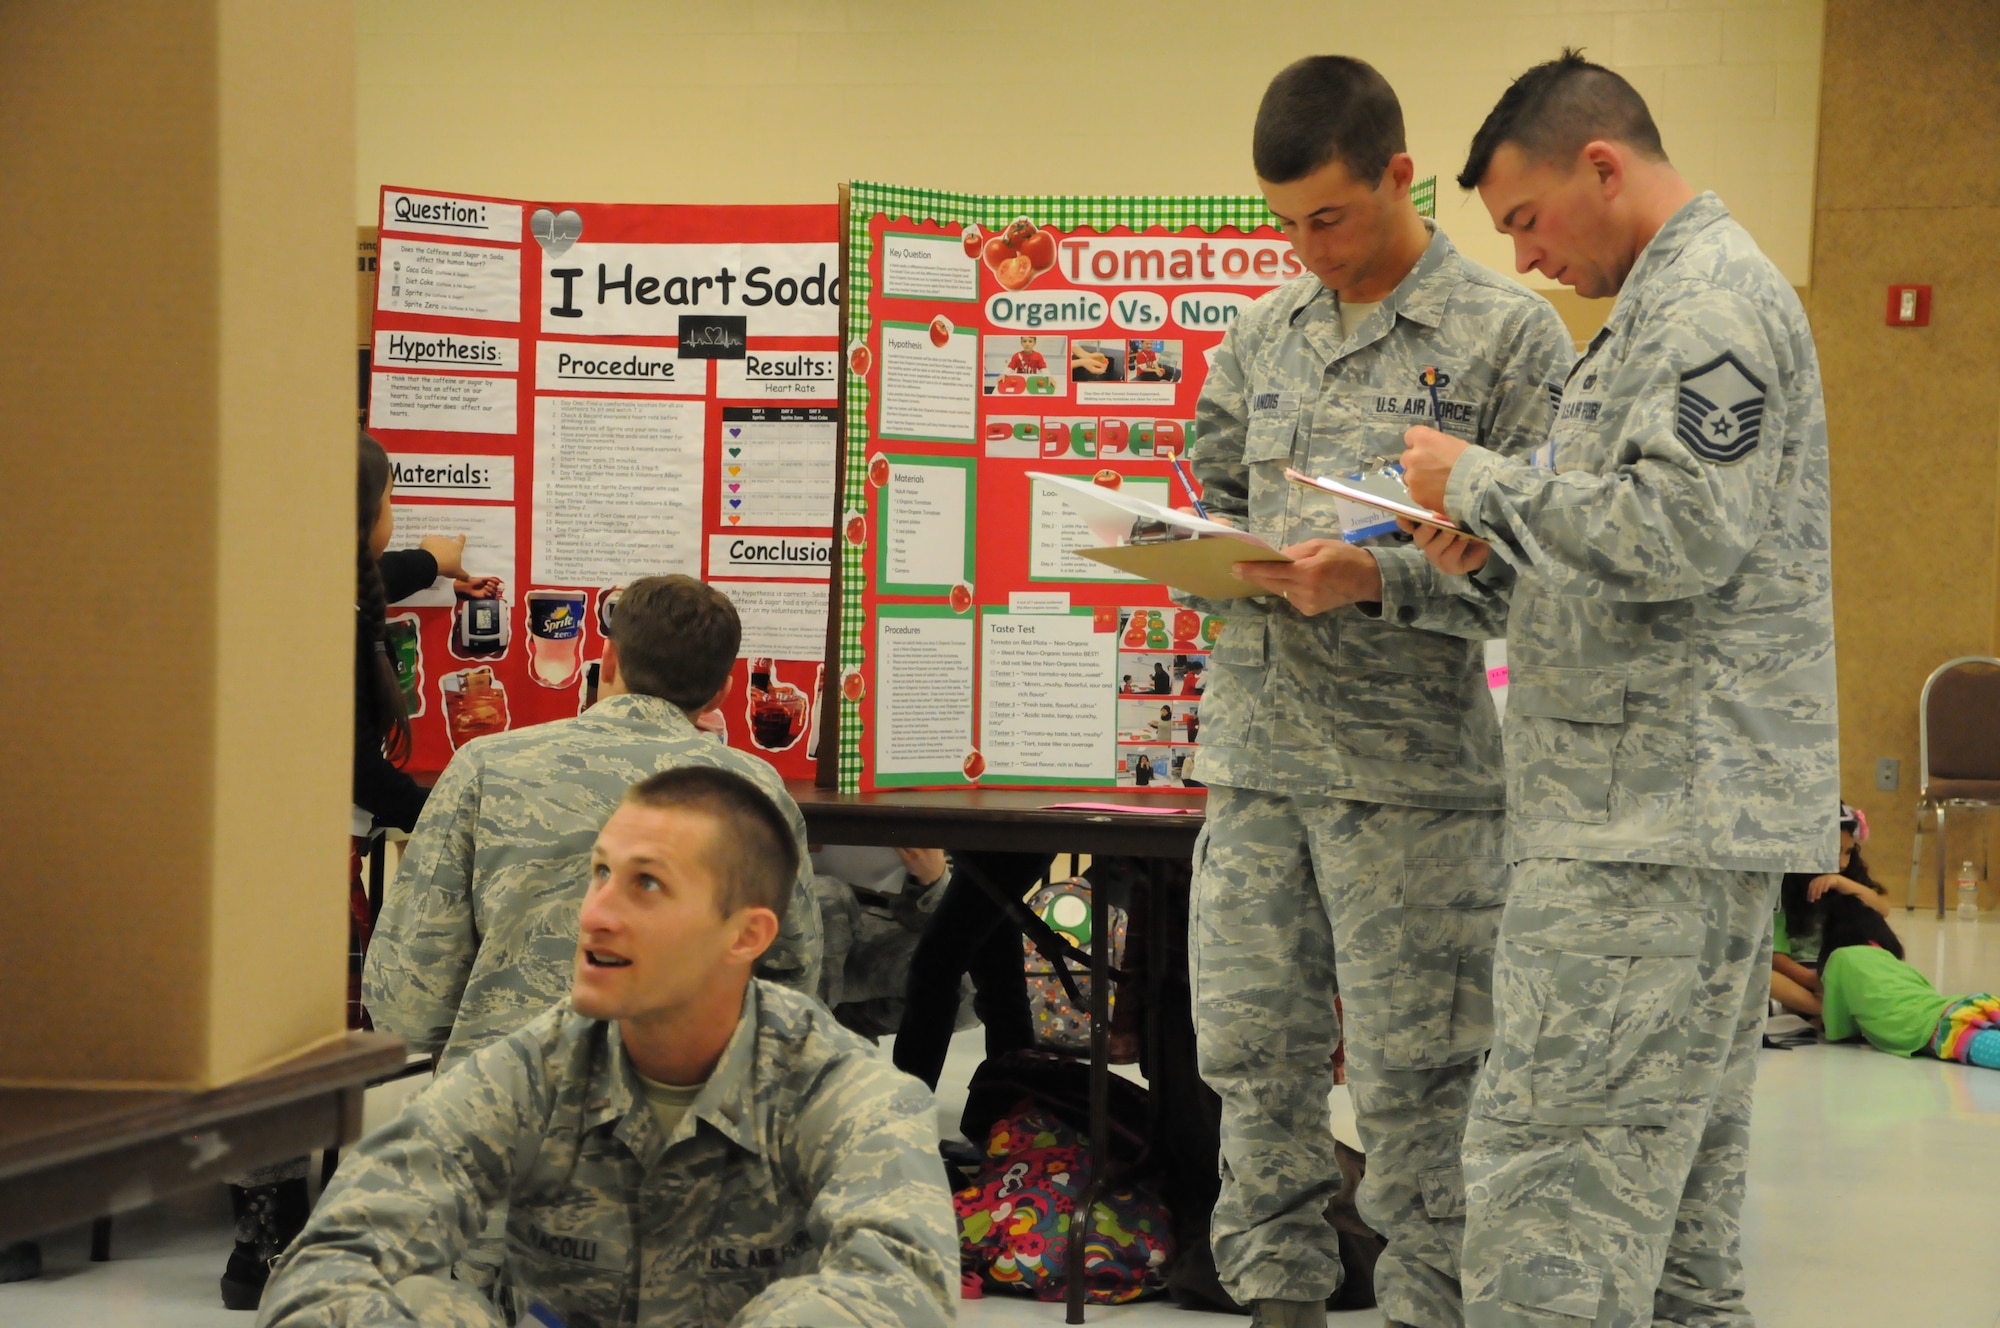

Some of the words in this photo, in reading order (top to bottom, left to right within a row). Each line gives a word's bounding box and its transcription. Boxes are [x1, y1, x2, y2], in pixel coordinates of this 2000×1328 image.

[395, 196, 486, 223] Question:
[427, 248, 449, 256] Caffeine
[464, 251, 480, 260] Sugar
[447, 258, 464, 266] human
[890, 248, 901, 258] Key
[903, 248, 931, 259] Question
[1062, 241, 1303, 279] Tomatoes
[406, 266, 419, 274] Coca
[405, 289, 422, 298] Sprite
[550, 268, 583, 318] I
[597, 263, 736, 305] Heart
[404, 300, 422, 309] Sprite
[991, 296, 1101, 327] Organic
[1118, 299, 1161, 324] Vs.
[390, 334, 501, 362] Hypothesis:
[888, 339, 922, 349] Hypothesis
[558, 353, 675, 376] Procedure
[747, 355, 832, 376] Results:
[765, 383, 792, 392] Heart
[794, 384, 816, 392] Rate
[1254, 394, 1279, 411] LANDIS
[1376, 397, 1399, 413] U.S.
[1403, 398, 1425, 416] AIR
[390, 462, 488, 483] Materials:
[894, 473, 924, 483] Materials
[542, 615, 574, 633] Sprite
[884, 625, 921, 634] Procedures
[991, 624, 1015, 634] Taste
[1018, 625, 1035, 634] Test
[749, 1249, 775, 1268] AIR
